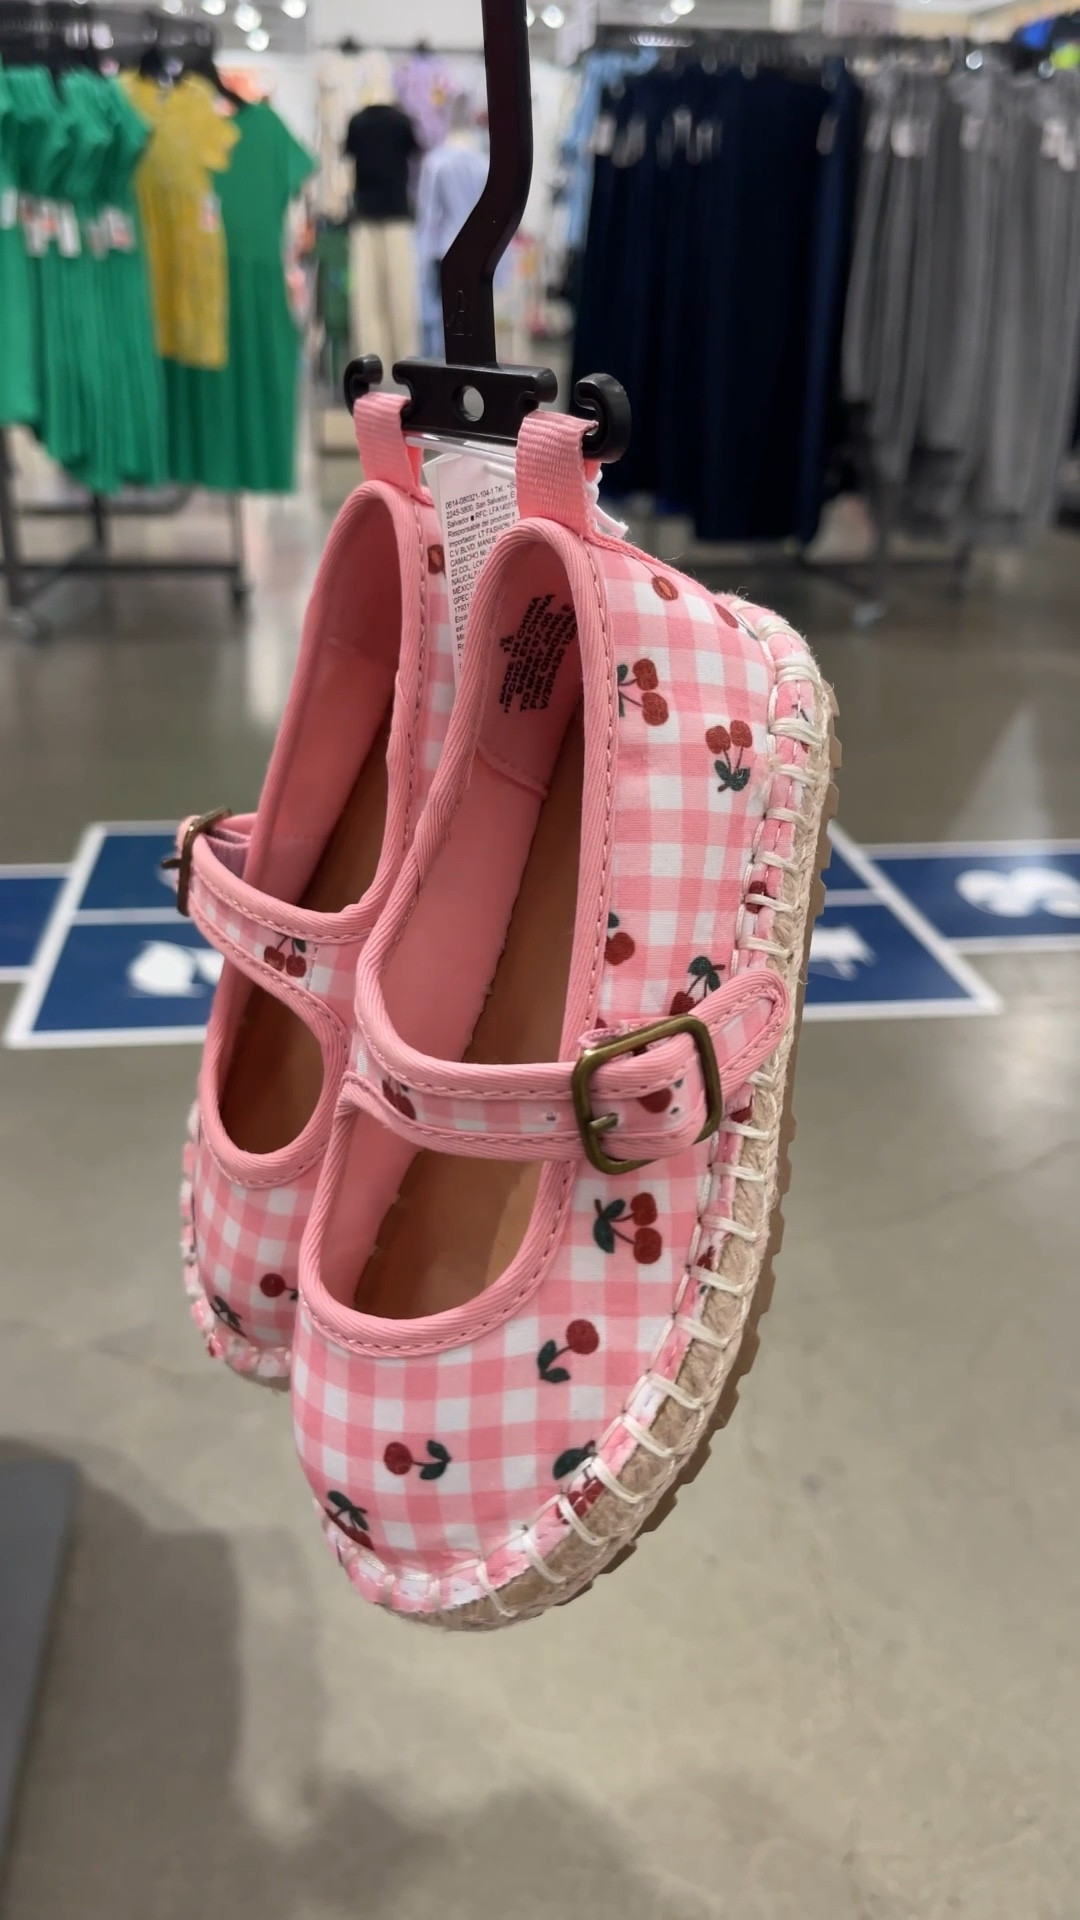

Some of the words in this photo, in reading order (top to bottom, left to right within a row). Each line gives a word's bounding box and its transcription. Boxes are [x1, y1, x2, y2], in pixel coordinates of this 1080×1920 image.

[475, 501, 486, 510] San
[447, 517, 469, 529] Salvador
[448, 523, 480, 537] Responsable
[481, 519, 489, 527] del
[490, 512, 511, 525] producto
[478, 530, 485, 538] LT
[450, 551, 479, 567] CAMACHO
[499, 661, 515, 705] MADE
[511, 641, 520, 658] IN
[517, 597, 542, 639] CHINA
[504, 660, 523, 713] HECHO
[519, 636, 531, 657] EN
[527, 594, 556, 634] CHINA
[526, 648, 544, 689] MARY
[529, 675, 545, 709] PINK
